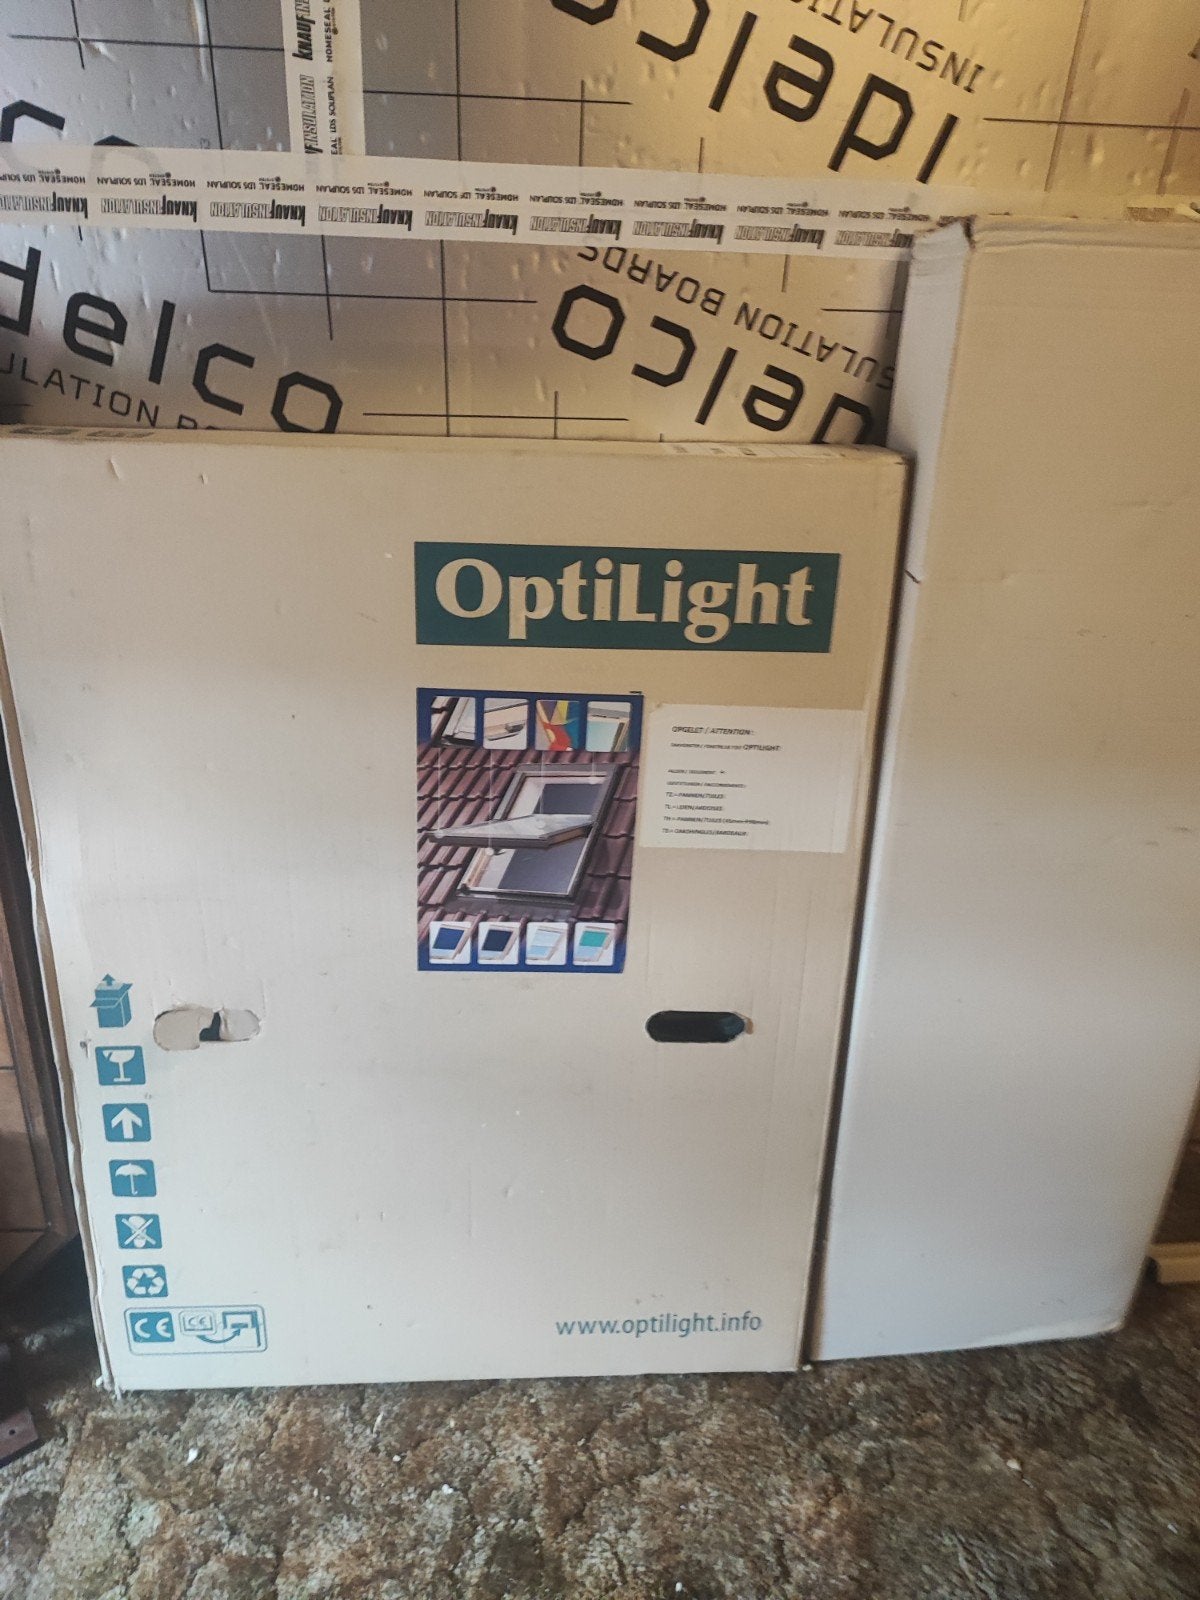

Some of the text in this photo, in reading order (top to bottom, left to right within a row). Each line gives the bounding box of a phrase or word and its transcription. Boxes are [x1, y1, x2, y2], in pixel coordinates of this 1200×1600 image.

[323, 7, 333, 62] HOMESEAL
[329, 119, 337, 133] LDS
[435, 557, 815, 644] OptiLight
[134, 1317, 172, 1339] CE
[556, 1310, 762, 1338] www.optilight.info
